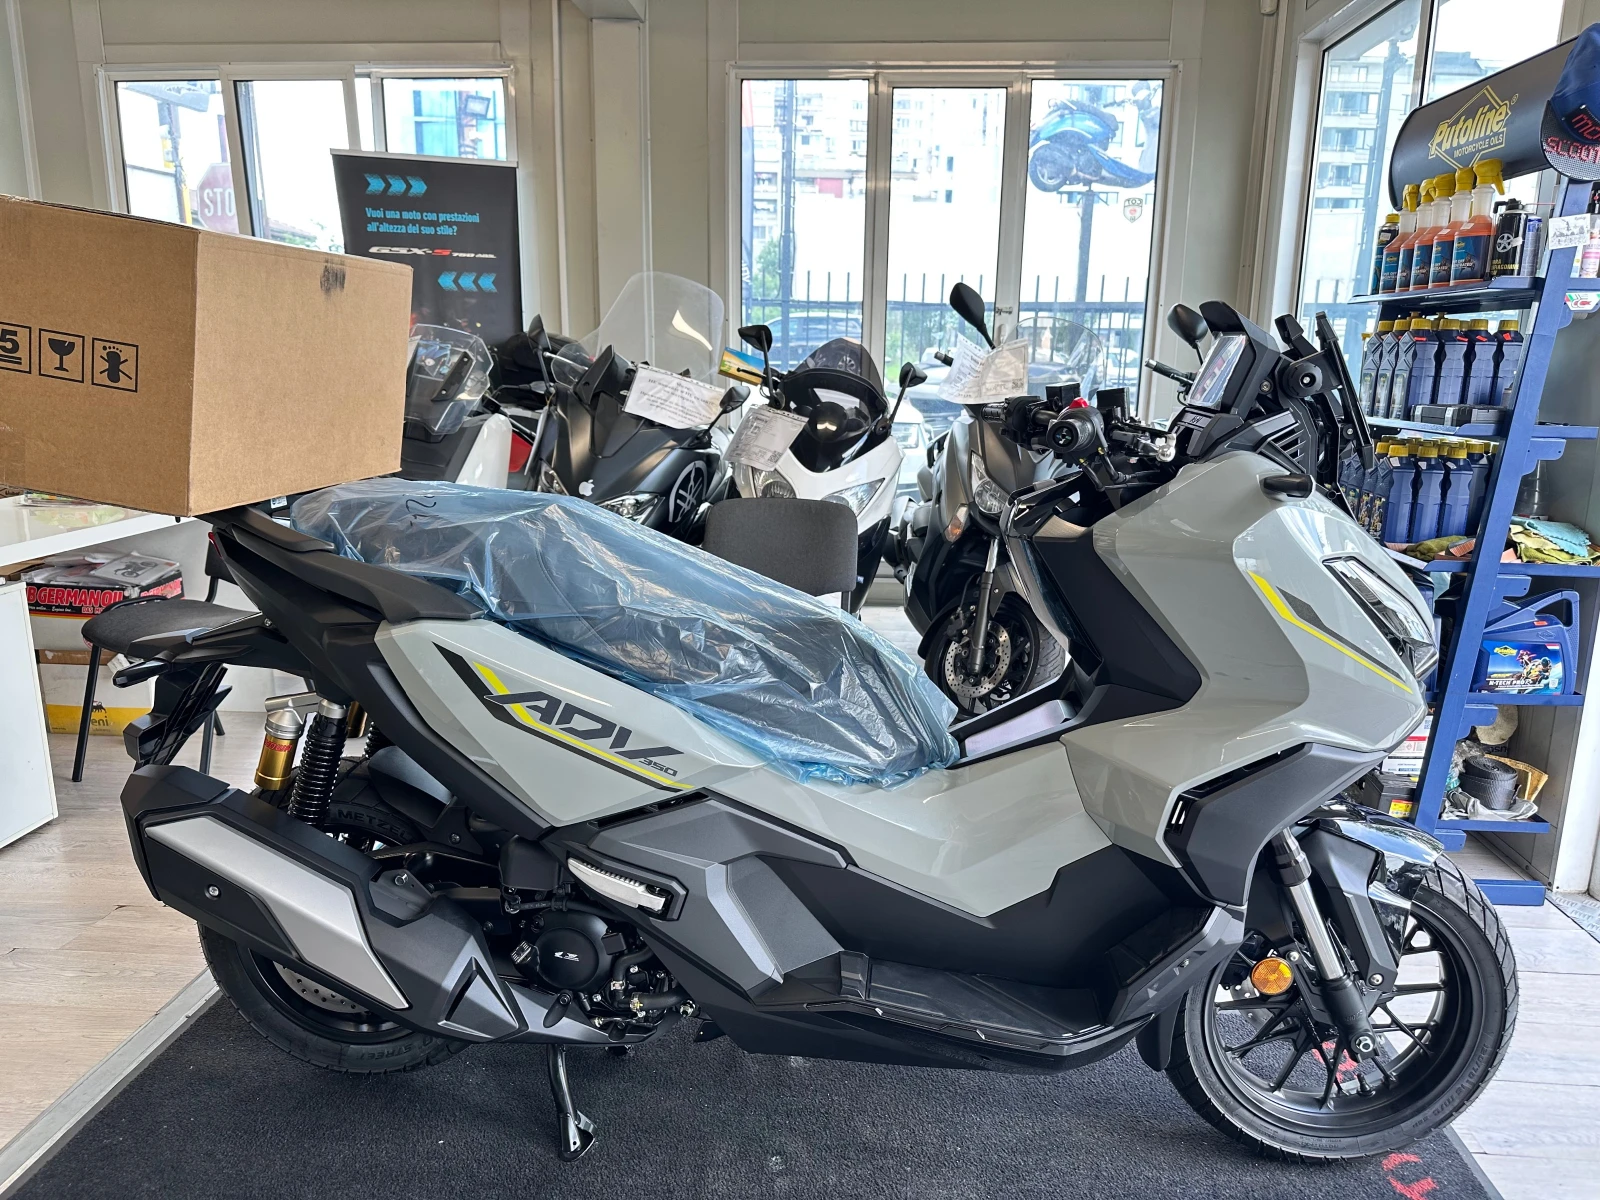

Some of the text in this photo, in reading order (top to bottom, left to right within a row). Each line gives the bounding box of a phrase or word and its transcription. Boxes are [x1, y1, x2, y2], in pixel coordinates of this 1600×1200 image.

[1432, 103, 1508, 154] Putoline
[1454, 134, 1503, 158] MOTORCYCLE OILS
[204, 188, 235, 216] STO
[365, 207, 480, 223] Vuoi una moto con prestazioni
[367, 222, 458, 236] all'altezza del suo stile?
[368, 246, 452, 256] GSX-S
[81, 606, 94, 614] DAS
[90, 715, 109, 727] eni
[484, 691, 685, 760] ADV
[638, 757, 679, 777] 350
[337, 809, 409, 842] METZEL
